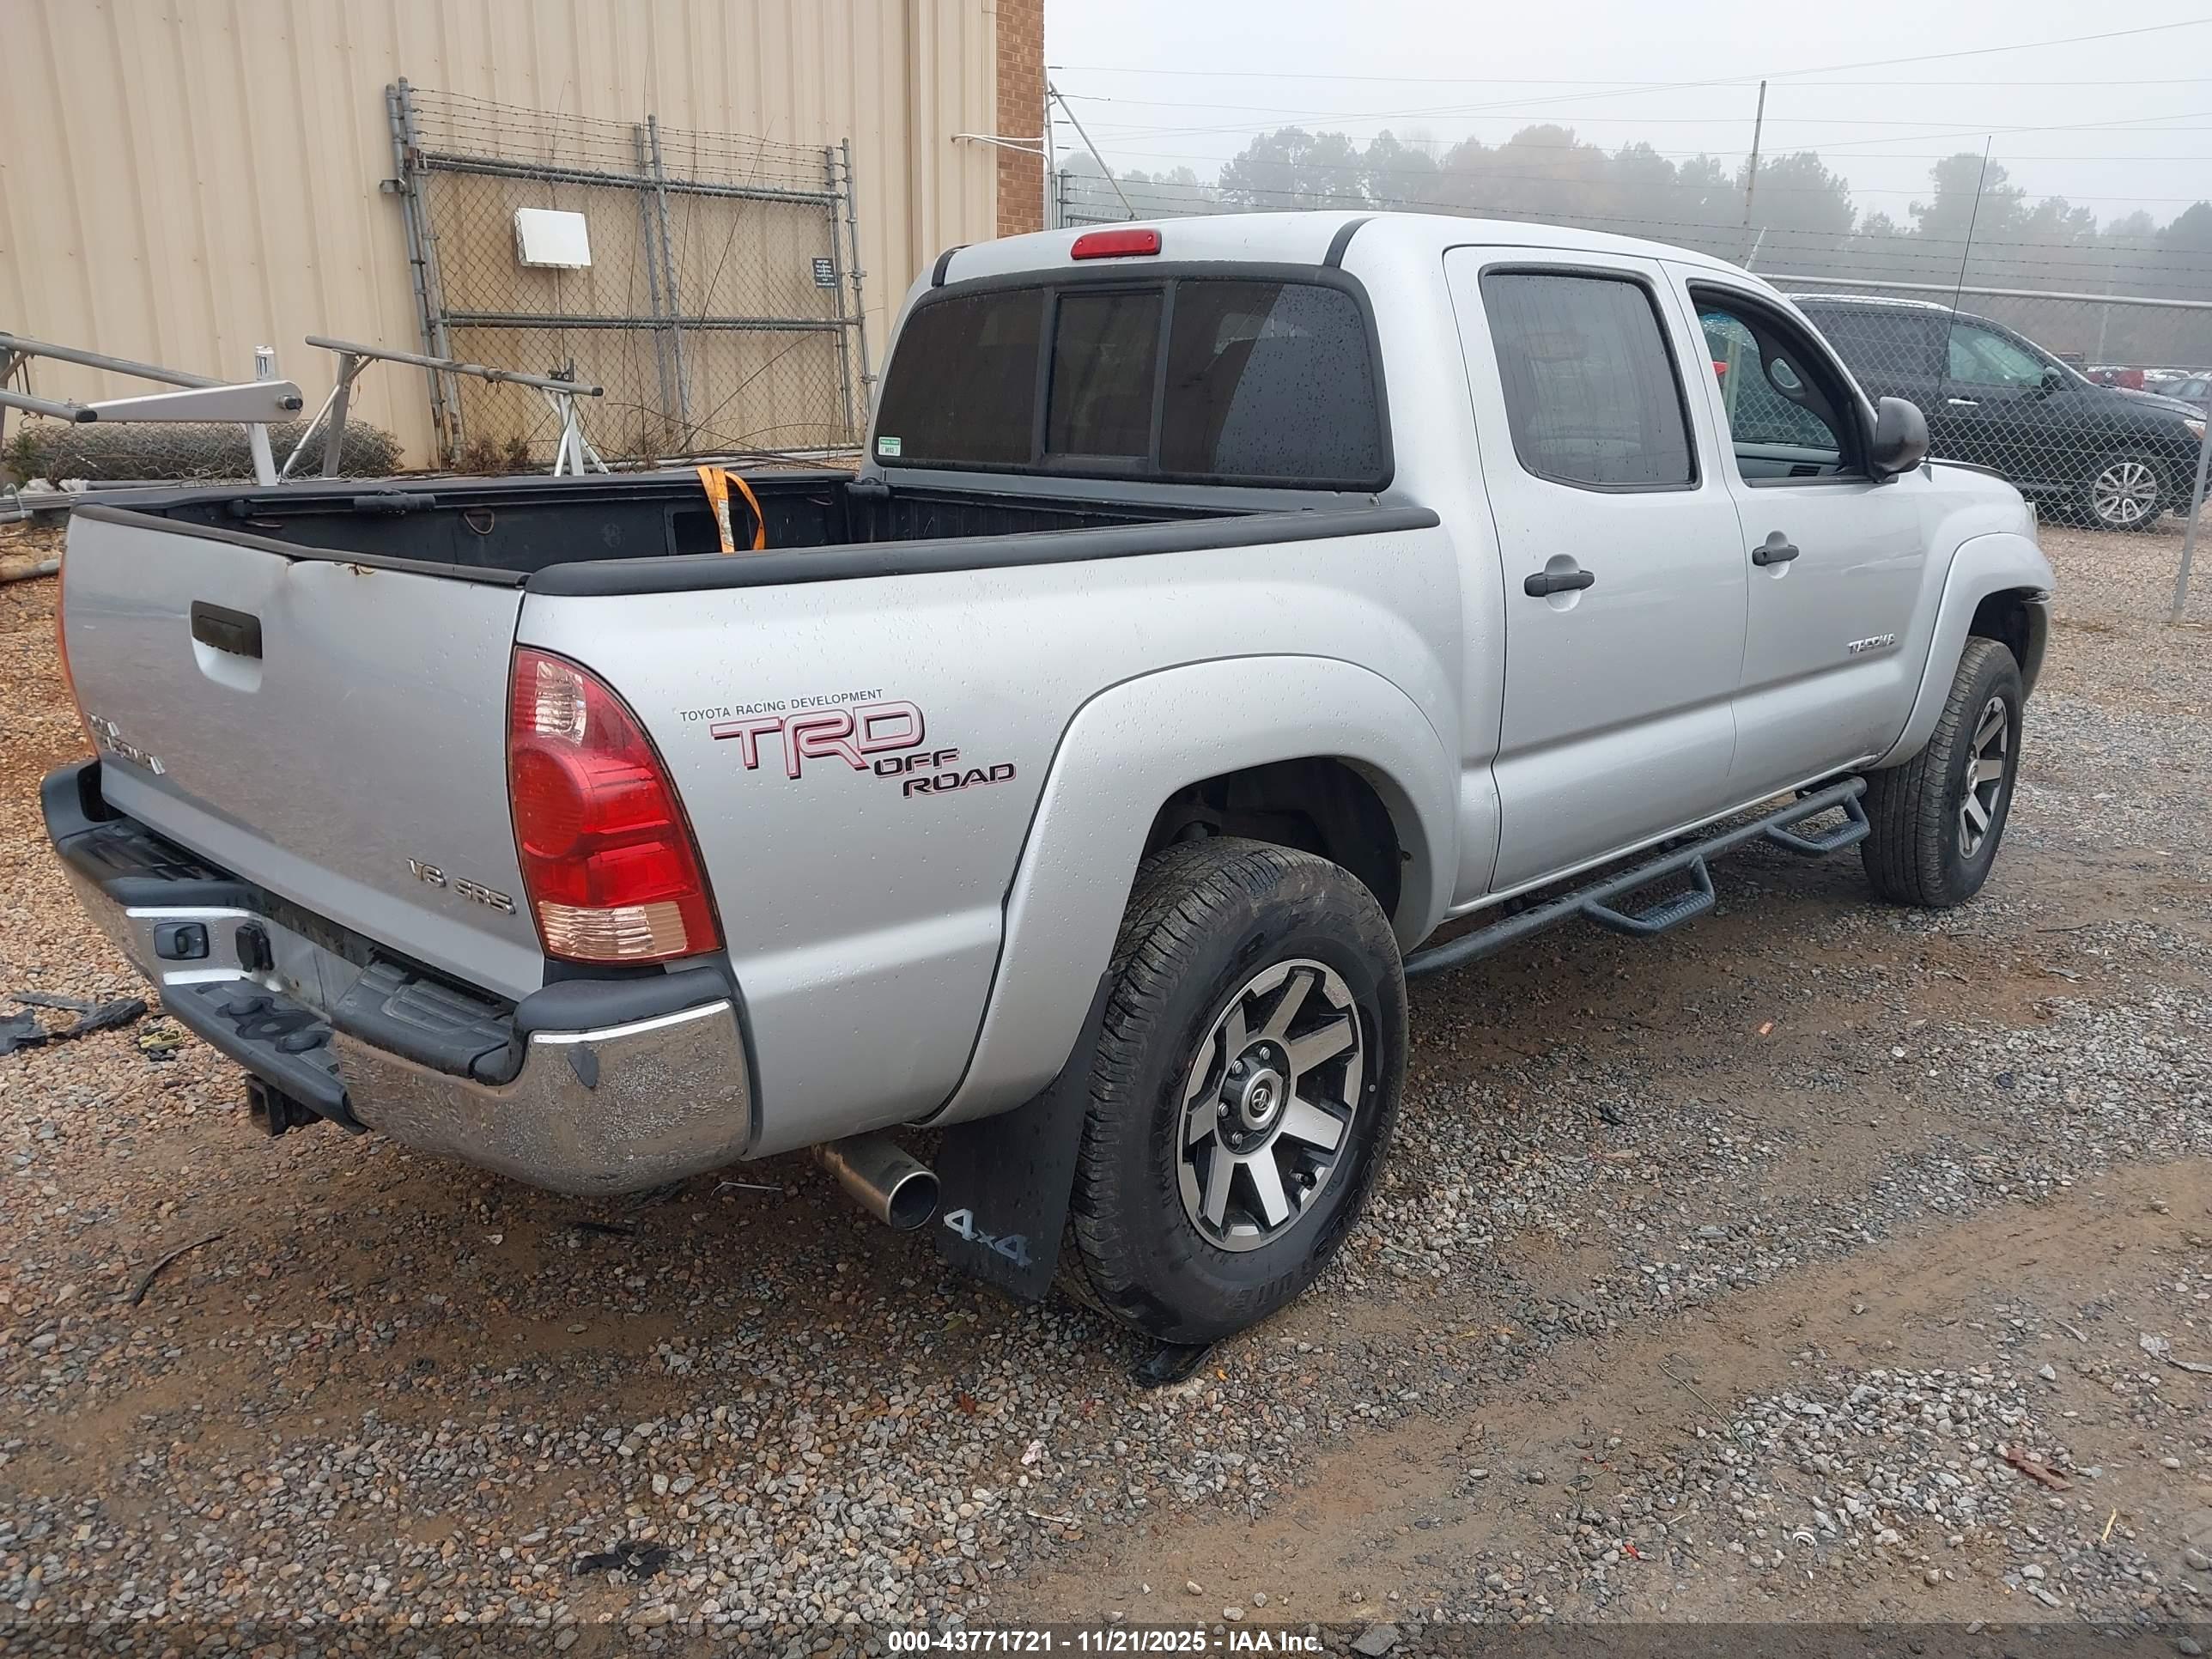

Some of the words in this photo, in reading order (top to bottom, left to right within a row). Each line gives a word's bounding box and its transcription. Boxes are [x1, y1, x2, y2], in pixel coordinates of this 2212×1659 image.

[680, 707, 731, 722] TOYOTA
[736, 698, 787, 714] RACING
[790, 689, 884, 709] DEVELOPMENT
[710, 700, 926, 780] TRD
[872, 747, 960, 778] OFF
[902, 763, 1017, 799] ROAD
[406, 858, 447, 887] V6
[453, 878, 516, 915] SR5
